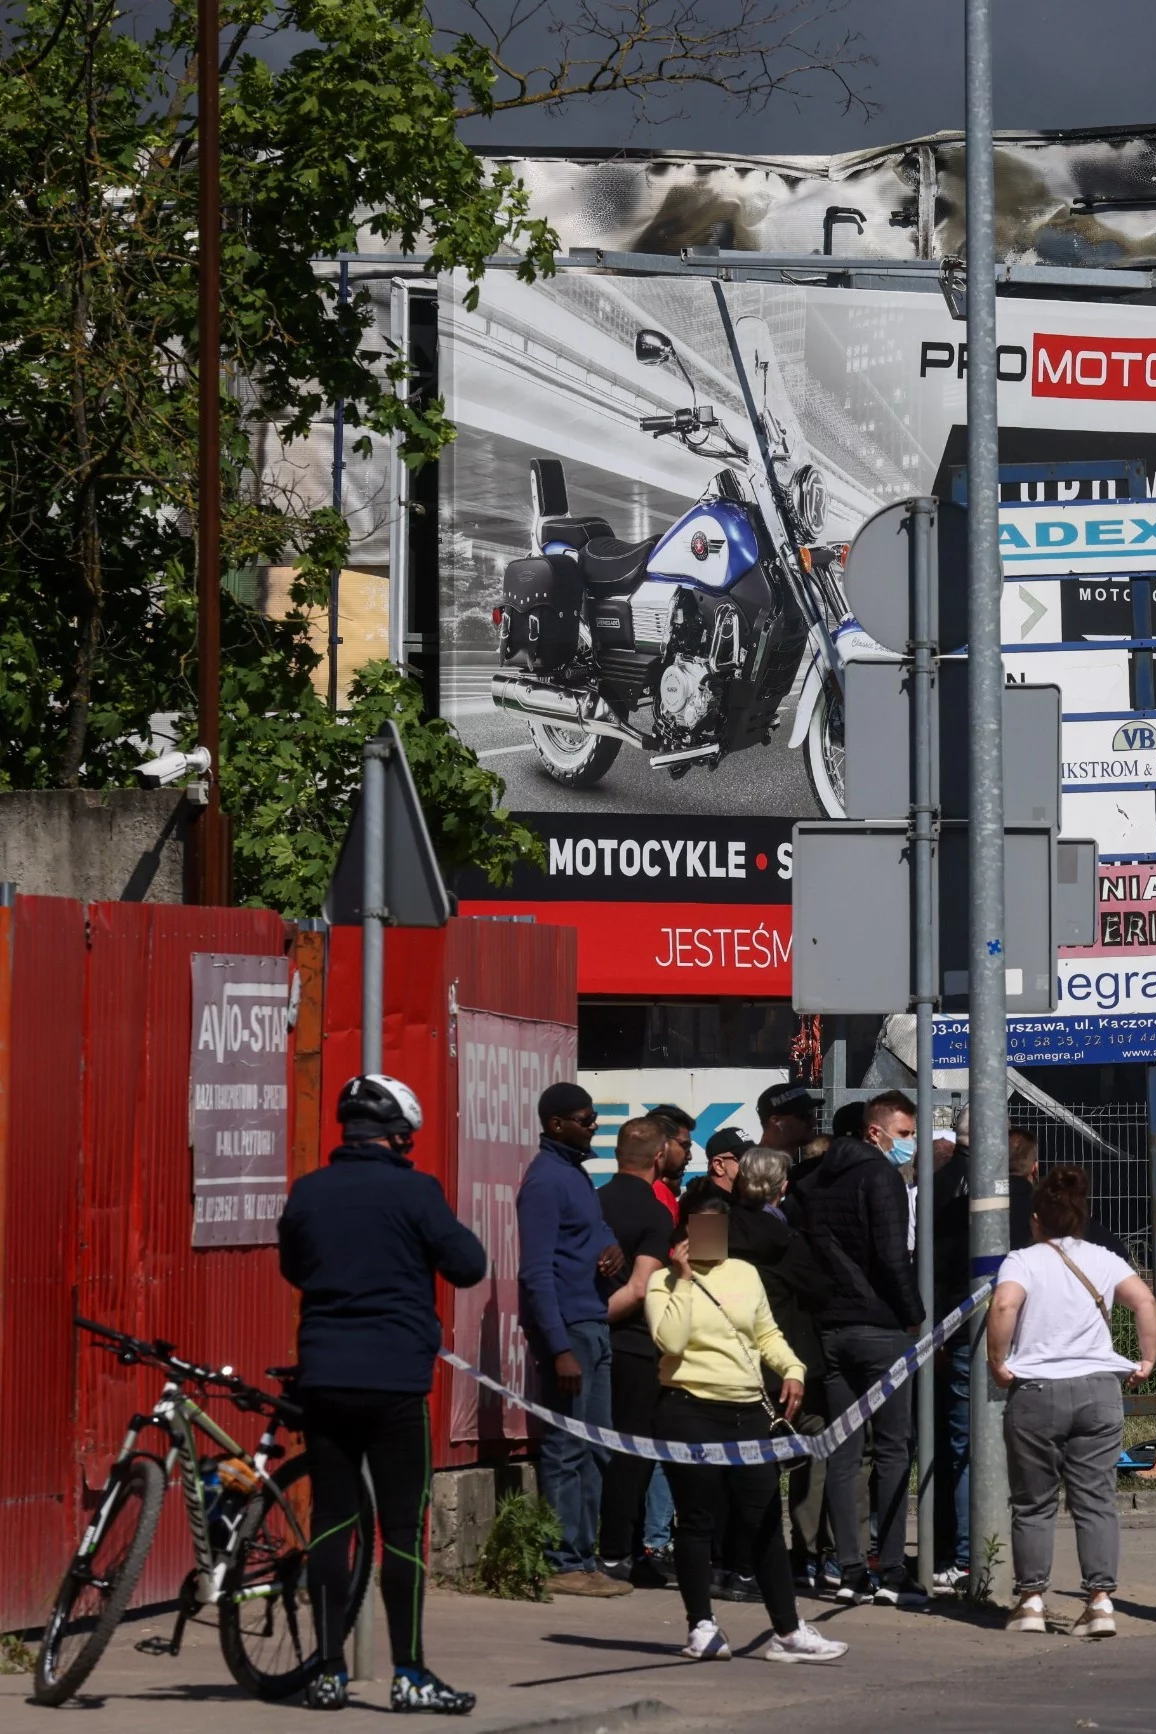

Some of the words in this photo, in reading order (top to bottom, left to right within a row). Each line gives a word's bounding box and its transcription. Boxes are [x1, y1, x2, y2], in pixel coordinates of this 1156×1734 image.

[1121, 728, 1156, 749] VB
[1143, 763, 1153, 776] &
[549, 838, 746, 878] MOTOCYKLE
[1006, 1021, 1070, 1034] rszawa,
[1074, 1019, 1094, 1030] ul.
